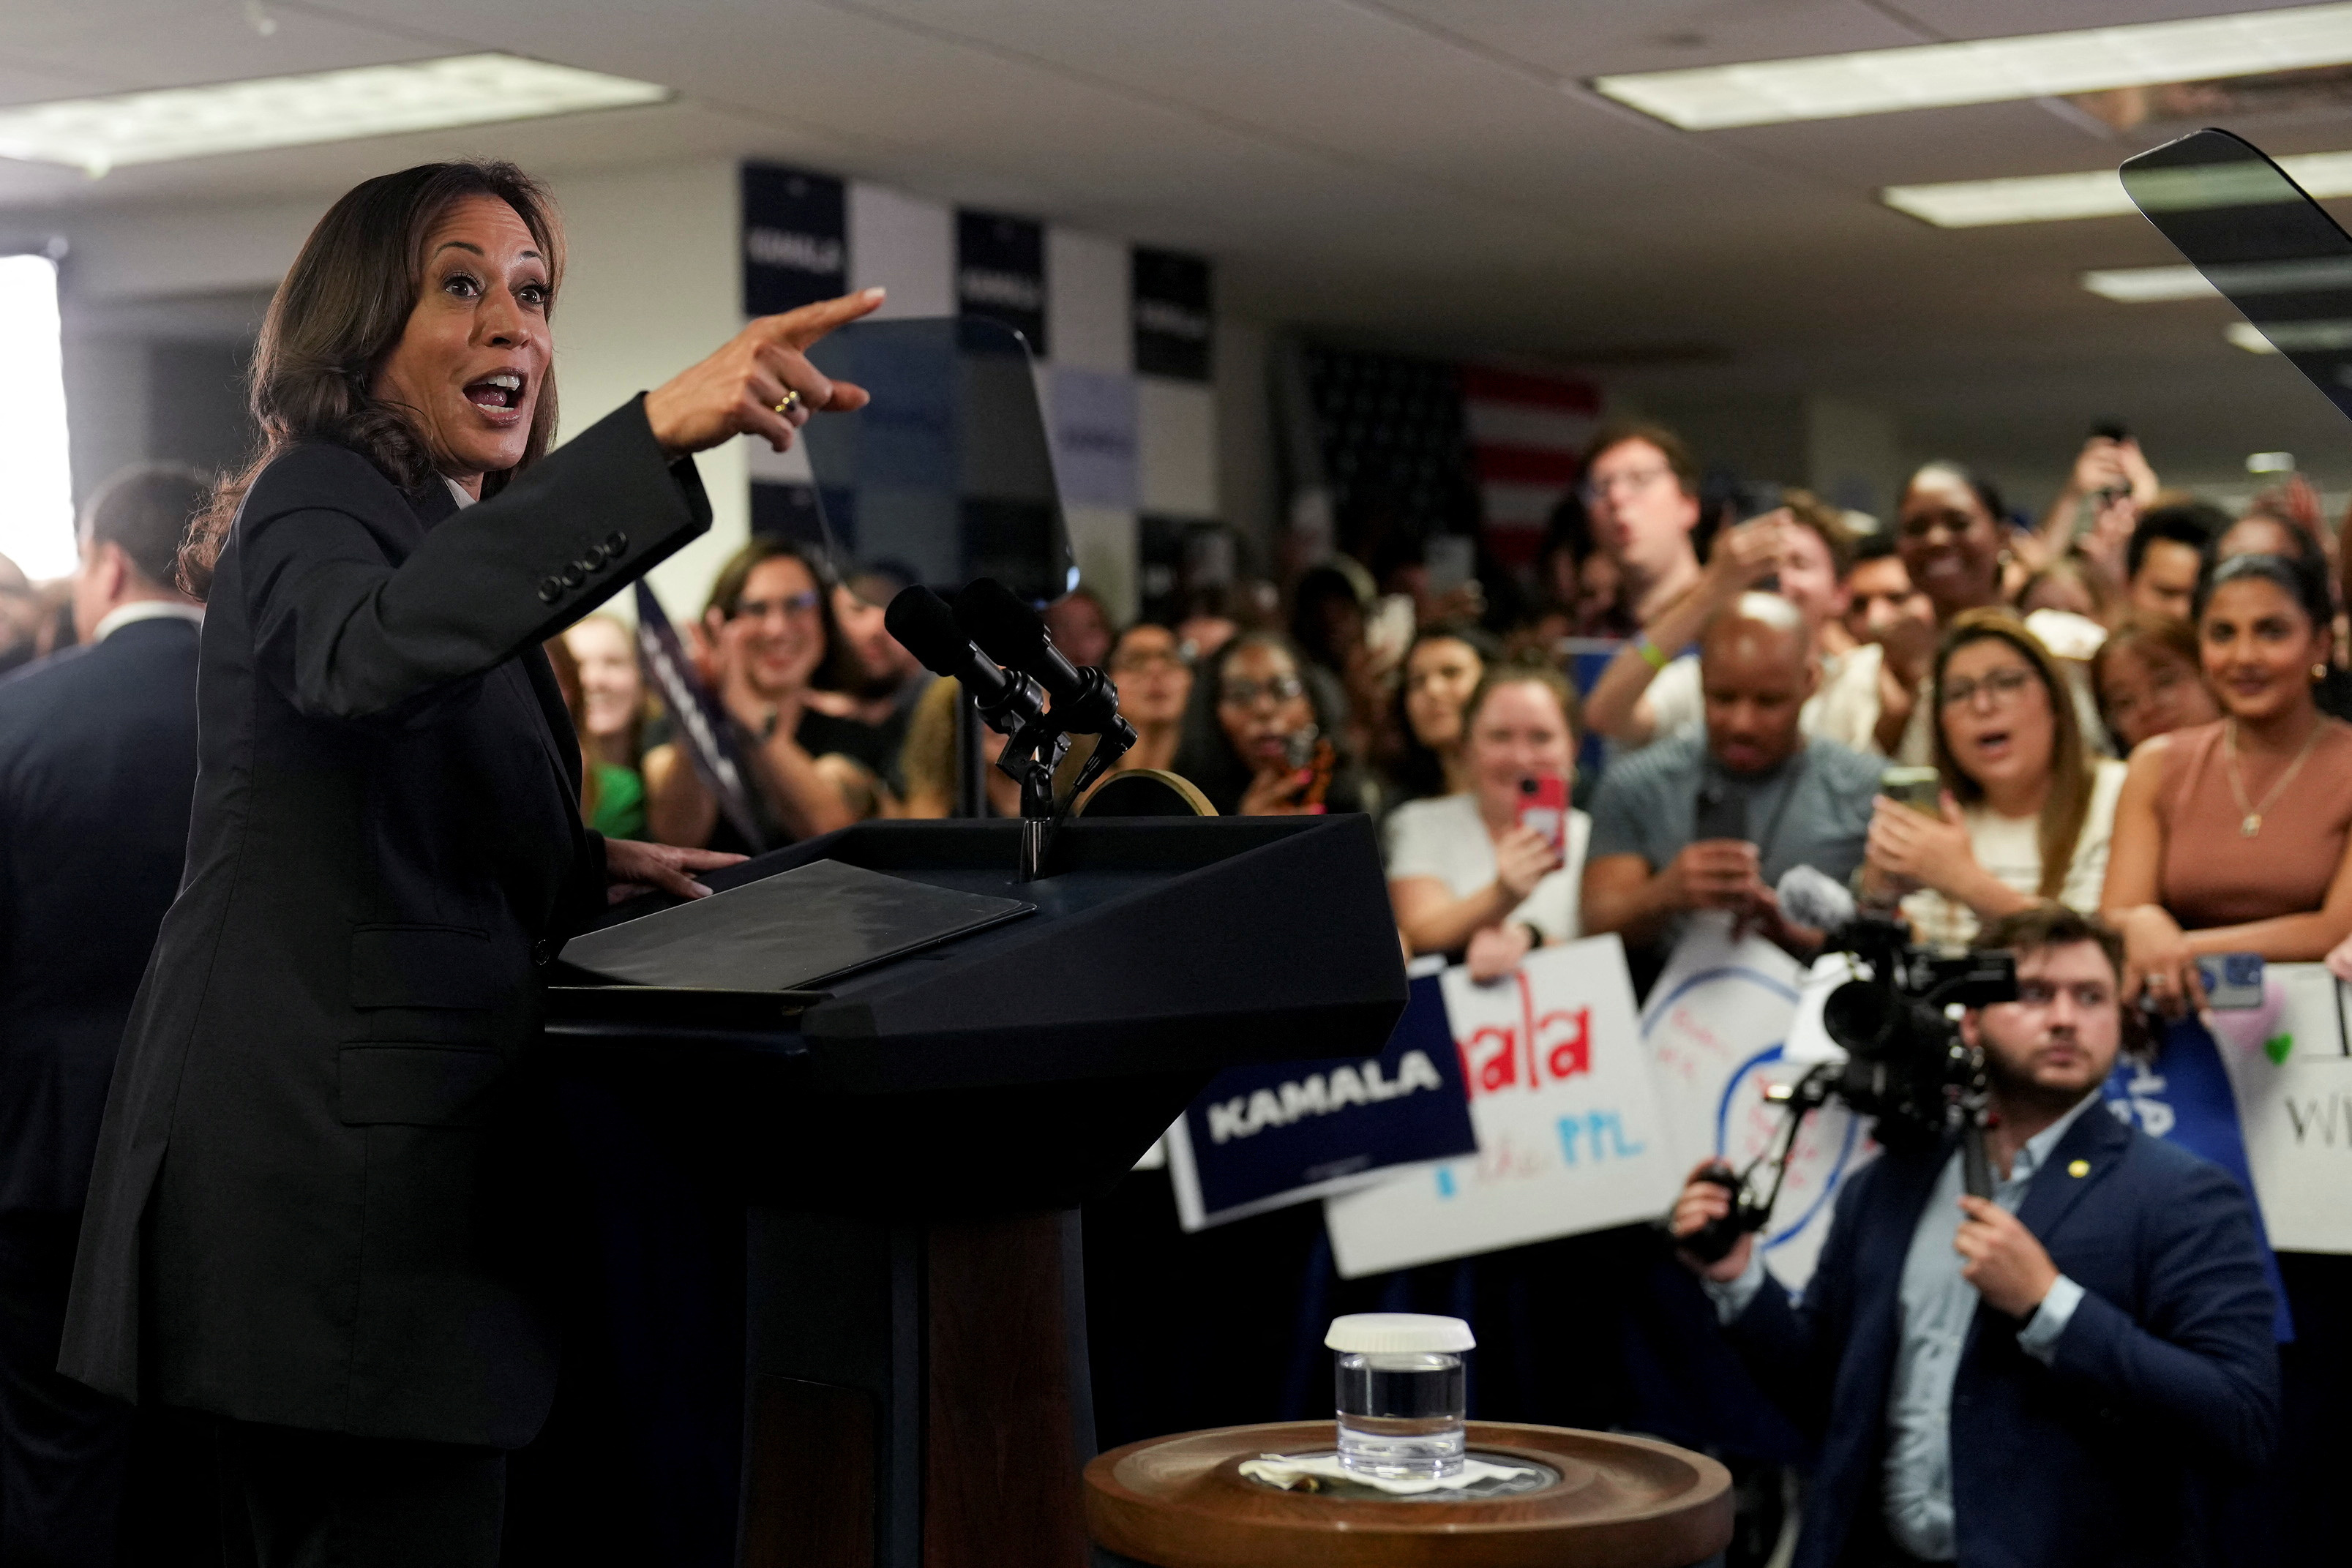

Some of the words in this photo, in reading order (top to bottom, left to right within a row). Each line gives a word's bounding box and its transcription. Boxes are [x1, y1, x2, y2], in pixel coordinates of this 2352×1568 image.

[1455, 967, 1593, 1101] ala
[1206, 1049, 1442, 1145] KAMALA
[1553, 1108, 1647, 1169] PPL
